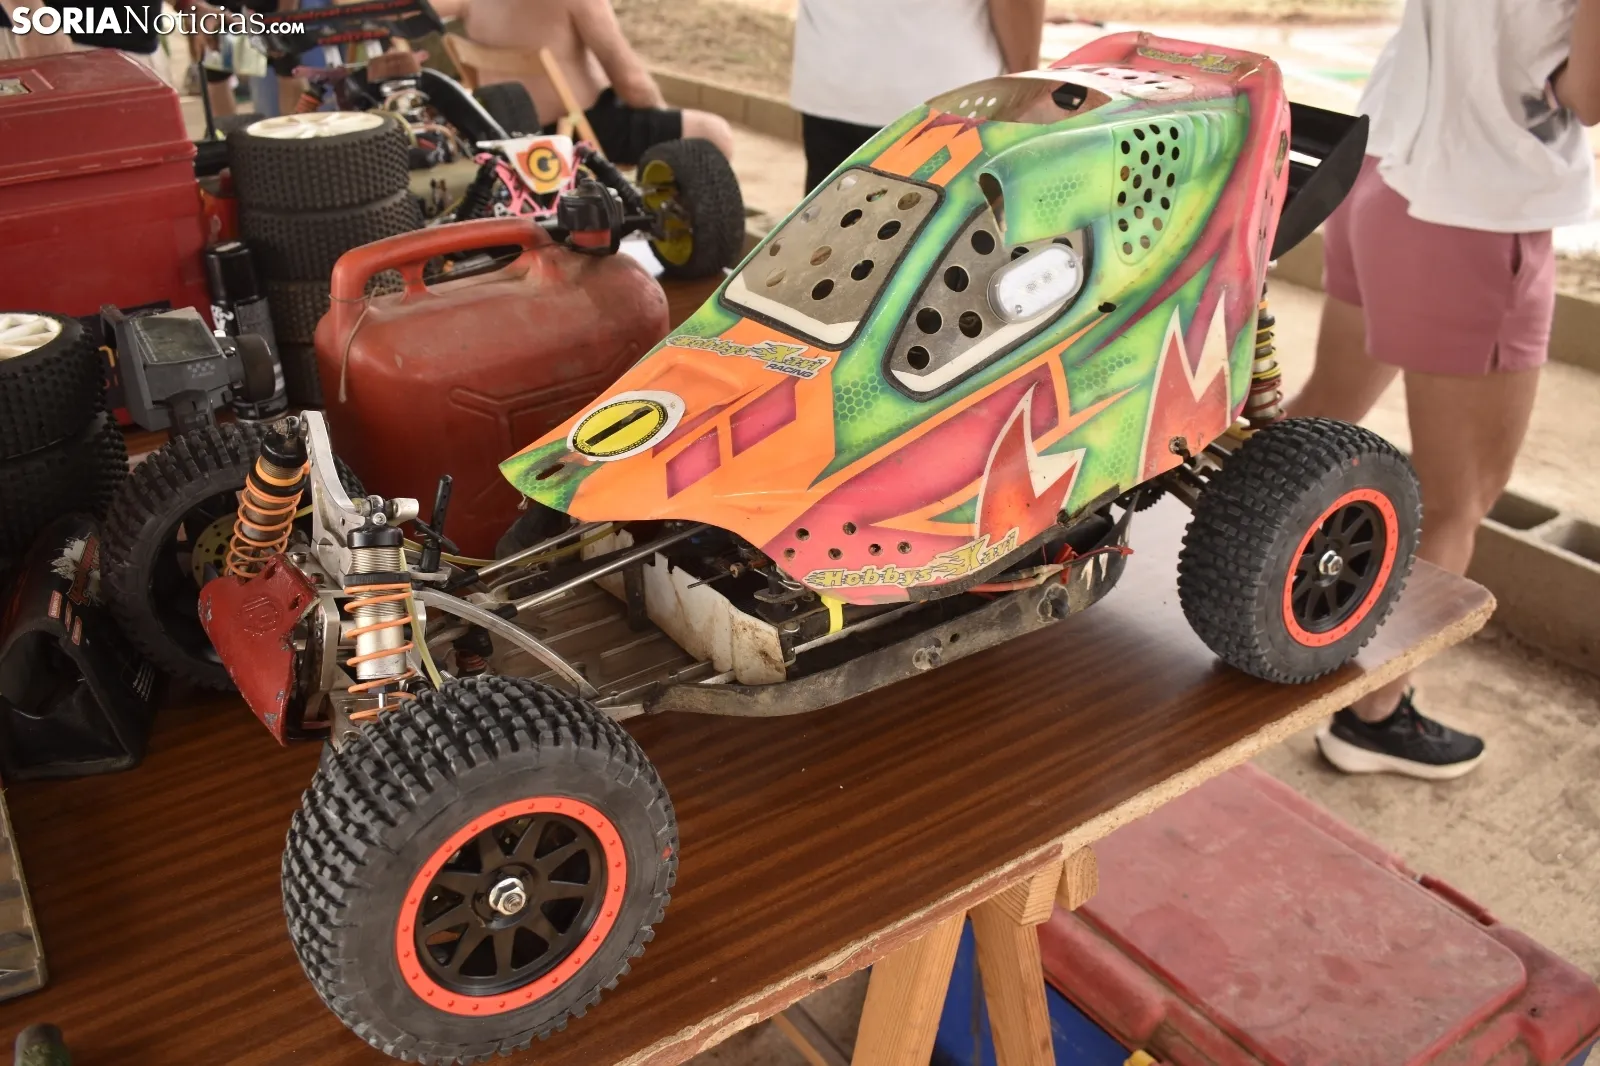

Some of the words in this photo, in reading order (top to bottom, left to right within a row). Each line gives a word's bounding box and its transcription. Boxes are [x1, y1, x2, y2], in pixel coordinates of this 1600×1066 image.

[529, 148, 560, 181] G
[669, 335, 750, 356] Hobbys
[751, 342, 827, 372] Xavi
[766, 363, 814, 378] RACING
[805, 567, 933, 587] Hobbys
[934, 530, 1017, 577] Xavi
